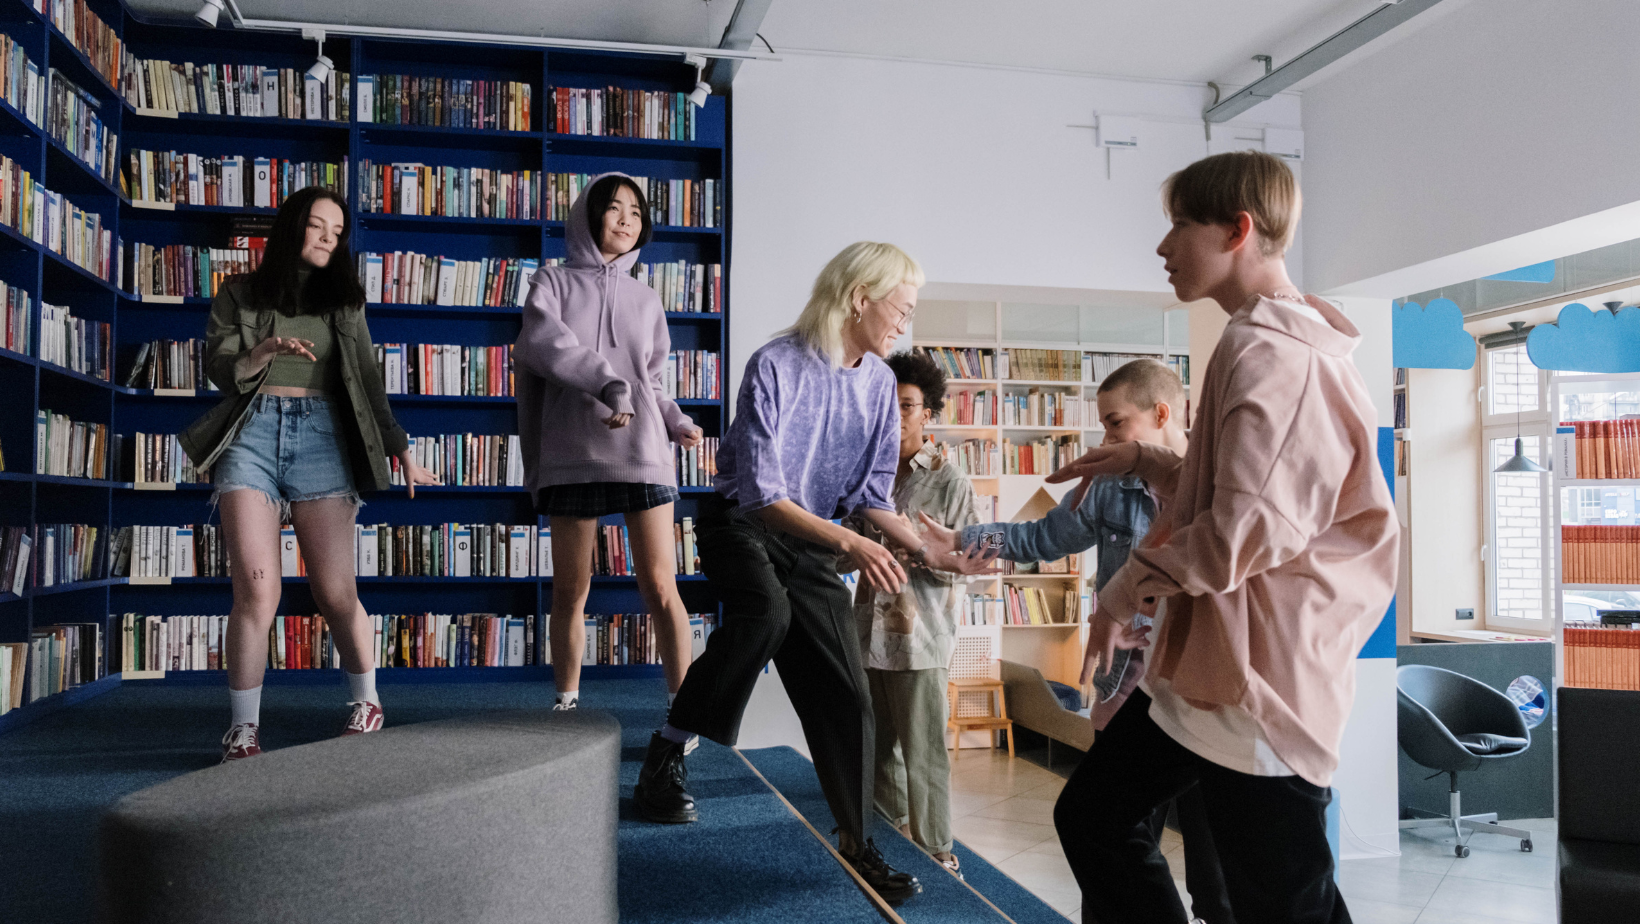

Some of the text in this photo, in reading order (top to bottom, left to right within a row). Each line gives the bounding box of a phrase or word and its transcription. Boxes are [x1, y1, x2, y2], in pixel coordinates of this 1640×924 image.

[267, 81, 274, 91] Н
[259, 171, 266, 180] О
[285, 541, 292, 550] С
[459, 541, 467, 551] Ф
[694, 630, 701, 639] Я
